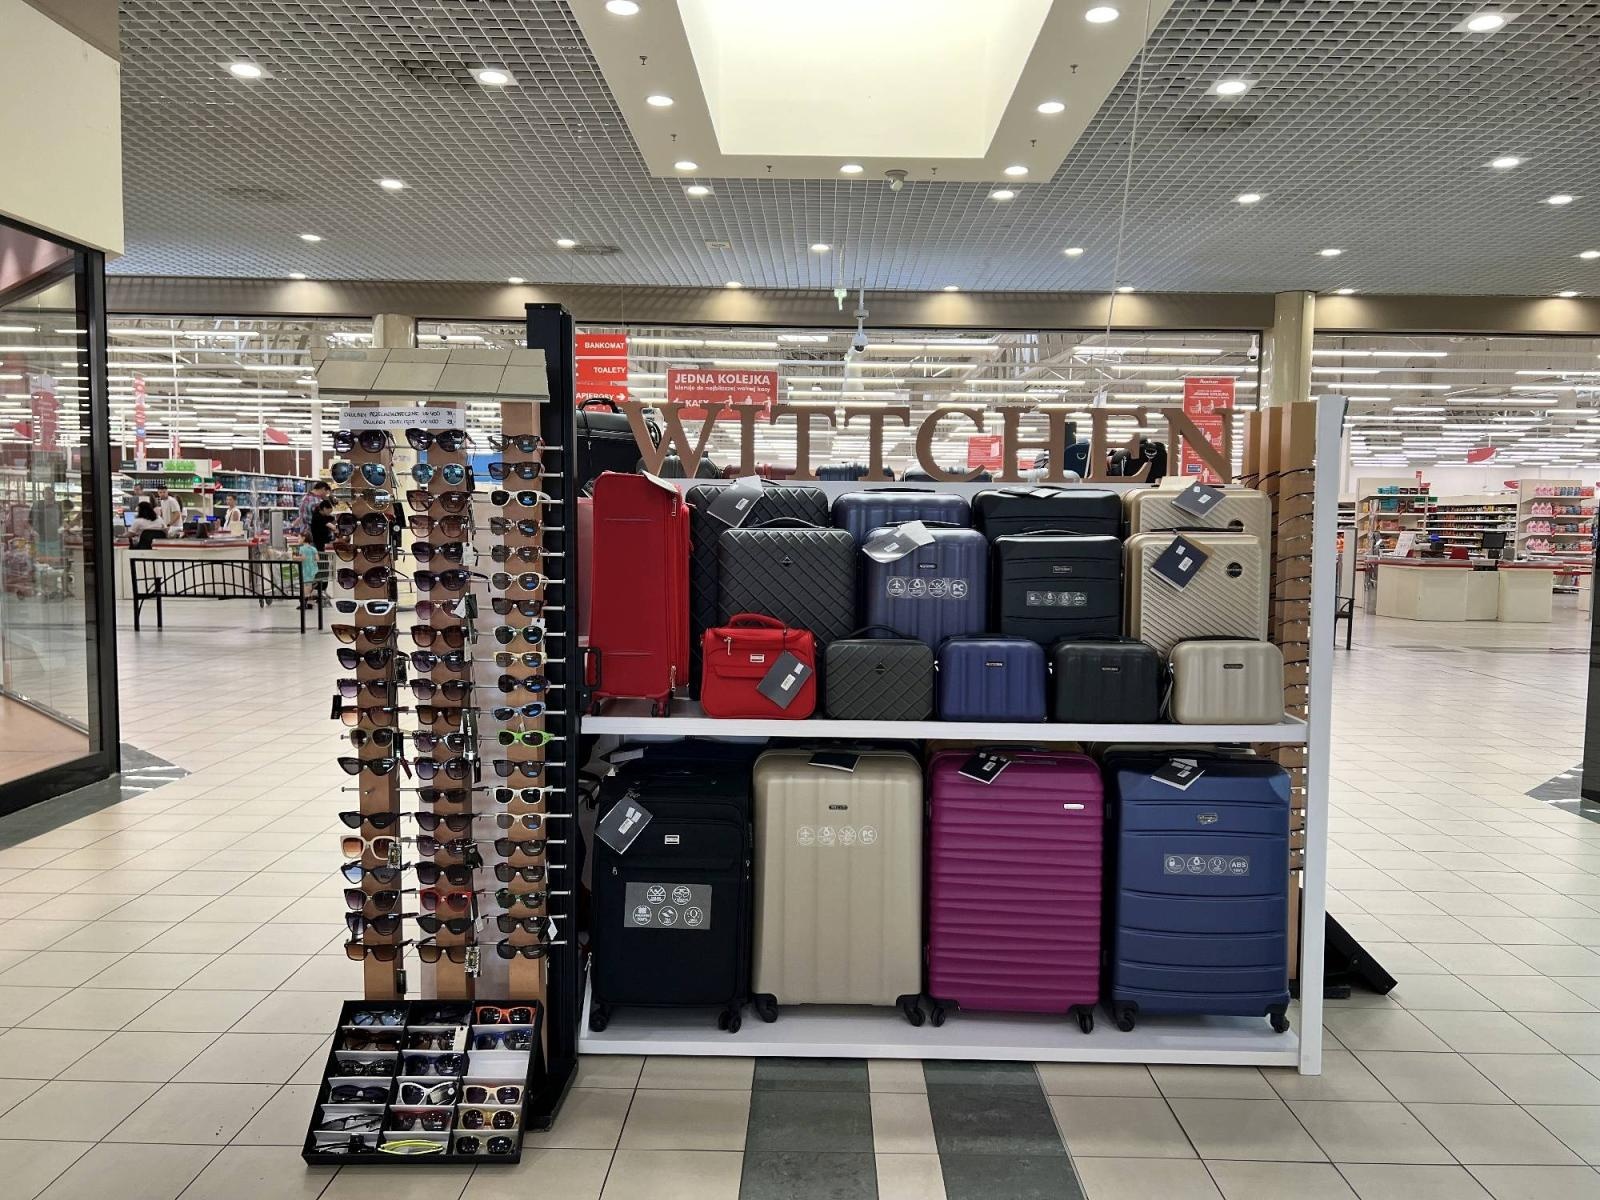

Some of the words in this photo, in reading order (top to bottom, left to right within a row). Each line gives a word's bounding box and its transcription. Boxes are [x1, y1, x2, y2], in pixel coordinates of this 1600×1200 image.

[675, 373, 715, 384] JEDNA
[718, 374, 771, 385] KOLEJKA
[575, 392, 615, 401] APIEROSY
[621, 401, 1244, 484] WITTCHEN
[953, 583, 964, 591] PC
